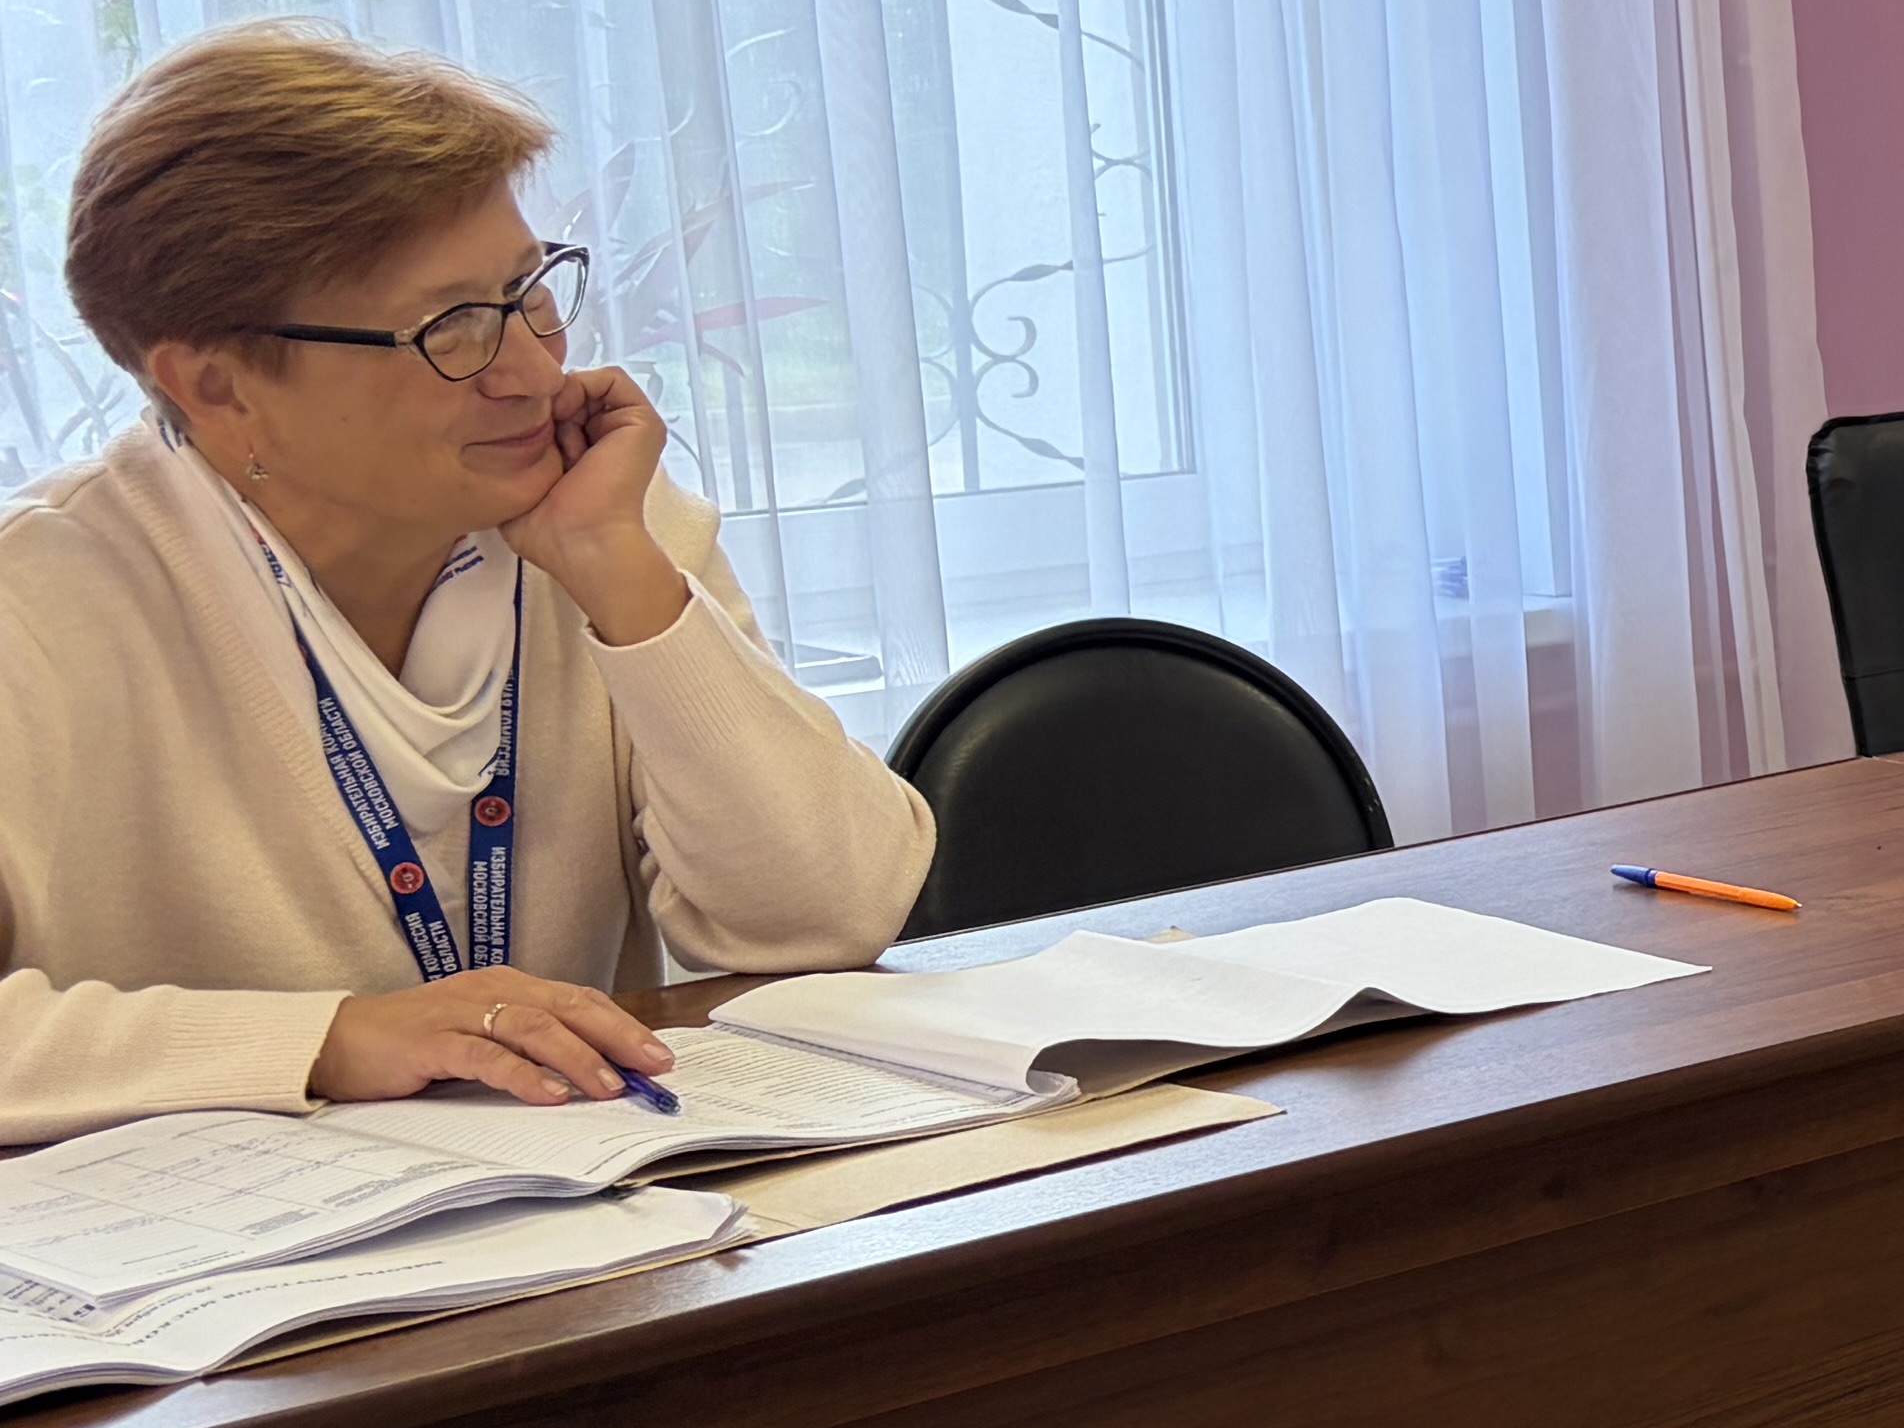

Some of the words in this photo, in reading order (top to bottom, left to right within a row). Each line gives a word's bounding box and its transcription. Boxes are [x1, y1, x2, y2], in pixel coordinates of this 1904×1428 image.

[319, 696, 358, 751] ОБЛАСТИ
[329, 753, 391, 850] ИЗБИРАТЕЛЬНАЯ
[346, 750, 400, 830] МОСКОВСКОЙ
[473, 860, 490, 943] МОСКОВСКОЙ
[490, 846, 507, 946] ИЗБИРАТЕЛЬНАЯ
[404, 911, 441, 973] КОМИССИЯ
[428, 920, 458, 973] ОБЛАСТИ
